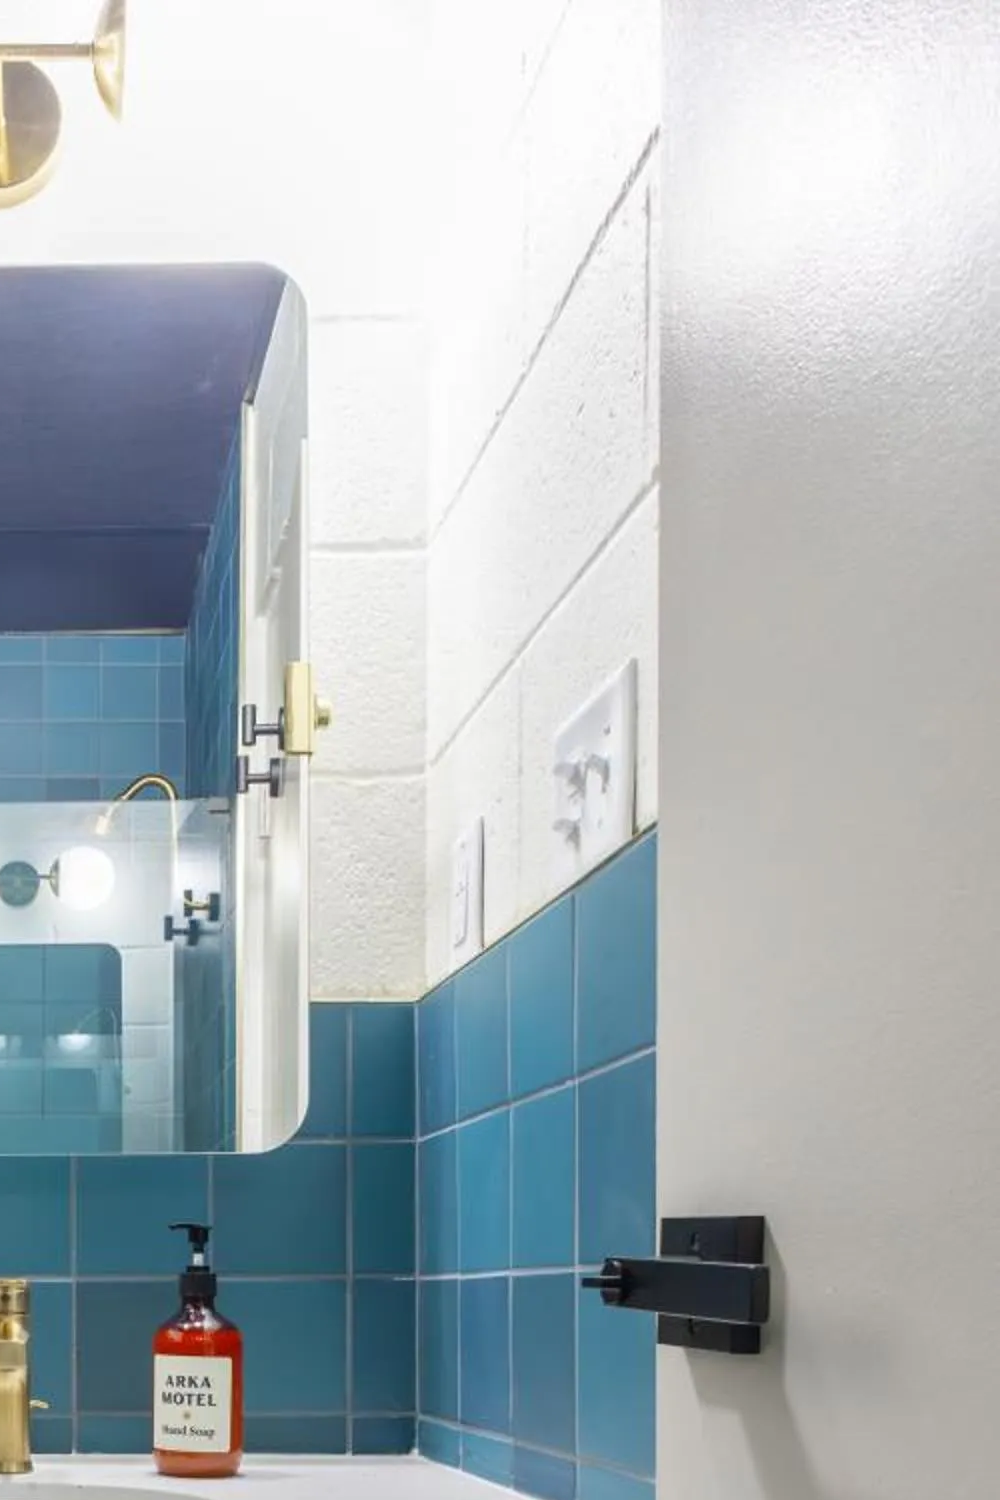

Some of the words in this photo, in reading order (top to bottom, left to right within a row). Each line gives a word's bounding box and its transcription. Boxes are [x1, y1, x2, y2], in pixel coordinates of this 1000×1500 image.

[165, 1375, 211, 1388] ARKA
[162, 1392, 216, 1407] MOTEL
[162, 1425, 187, 1435] Hand
[190, 1425, 215, 1439] Soap
